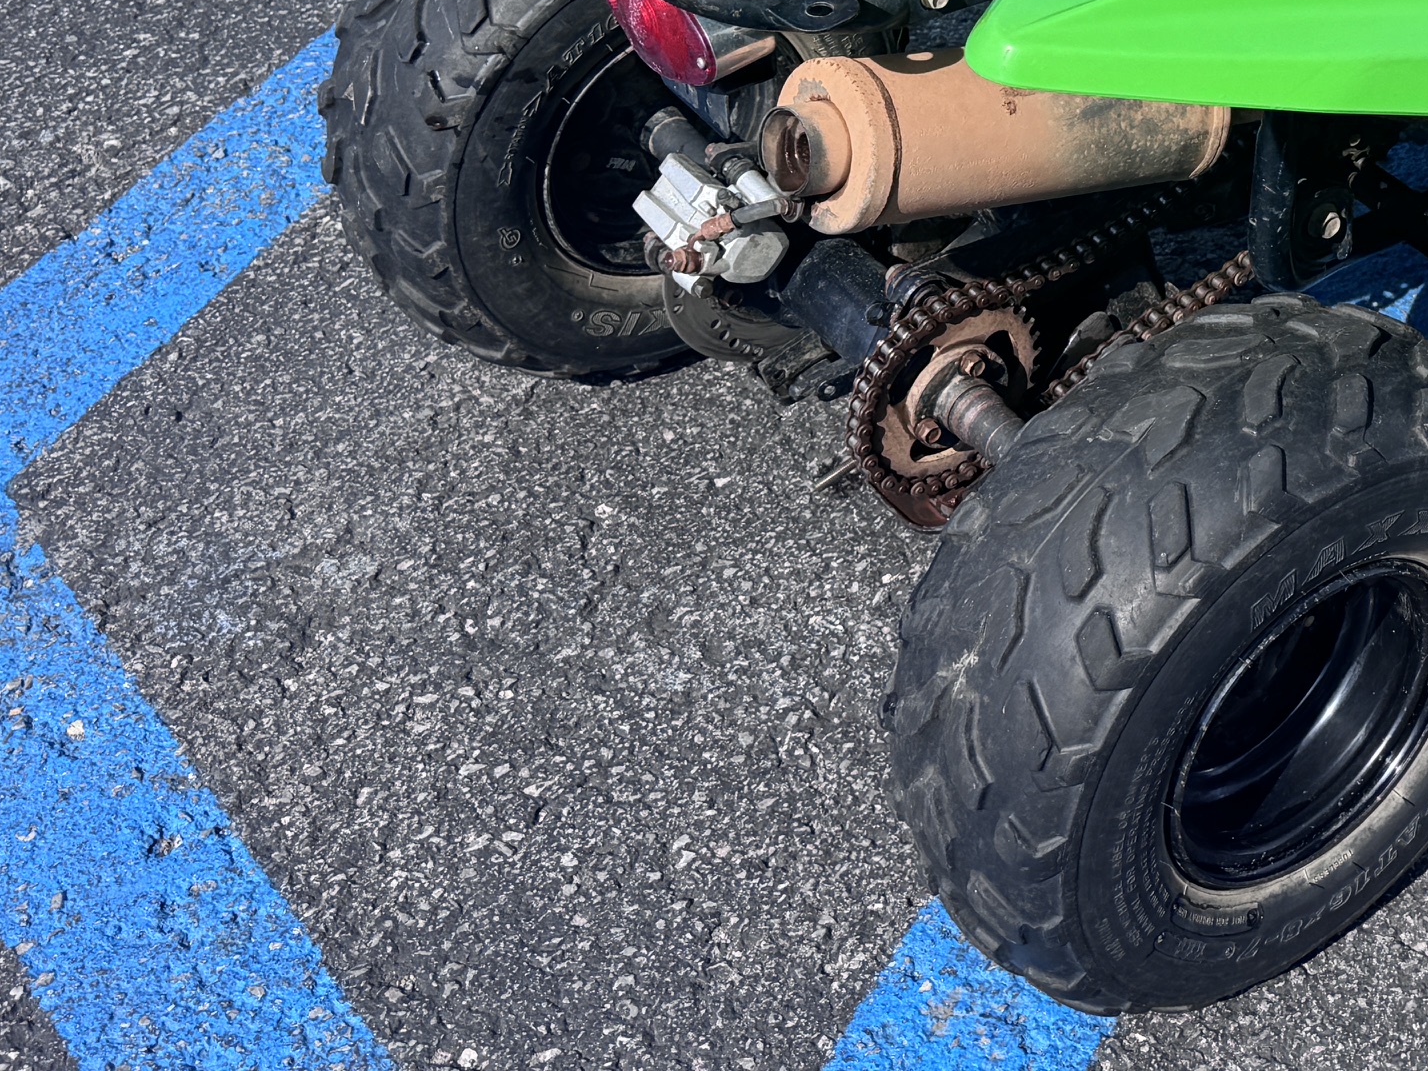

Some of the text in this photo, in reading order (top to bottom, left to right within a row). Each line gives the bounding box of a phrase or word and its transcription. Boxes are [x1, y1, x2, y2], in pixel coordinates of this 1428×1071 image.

[1127, 783, 1149, 865] OPERATING
[1112, 834, 1125, 879] LABEL
[1126, 865, 1137, 890] FOR
[1113, 881, 1129, 925] VEHICLE
[1130, 887, 1155, 935] MANUAL
